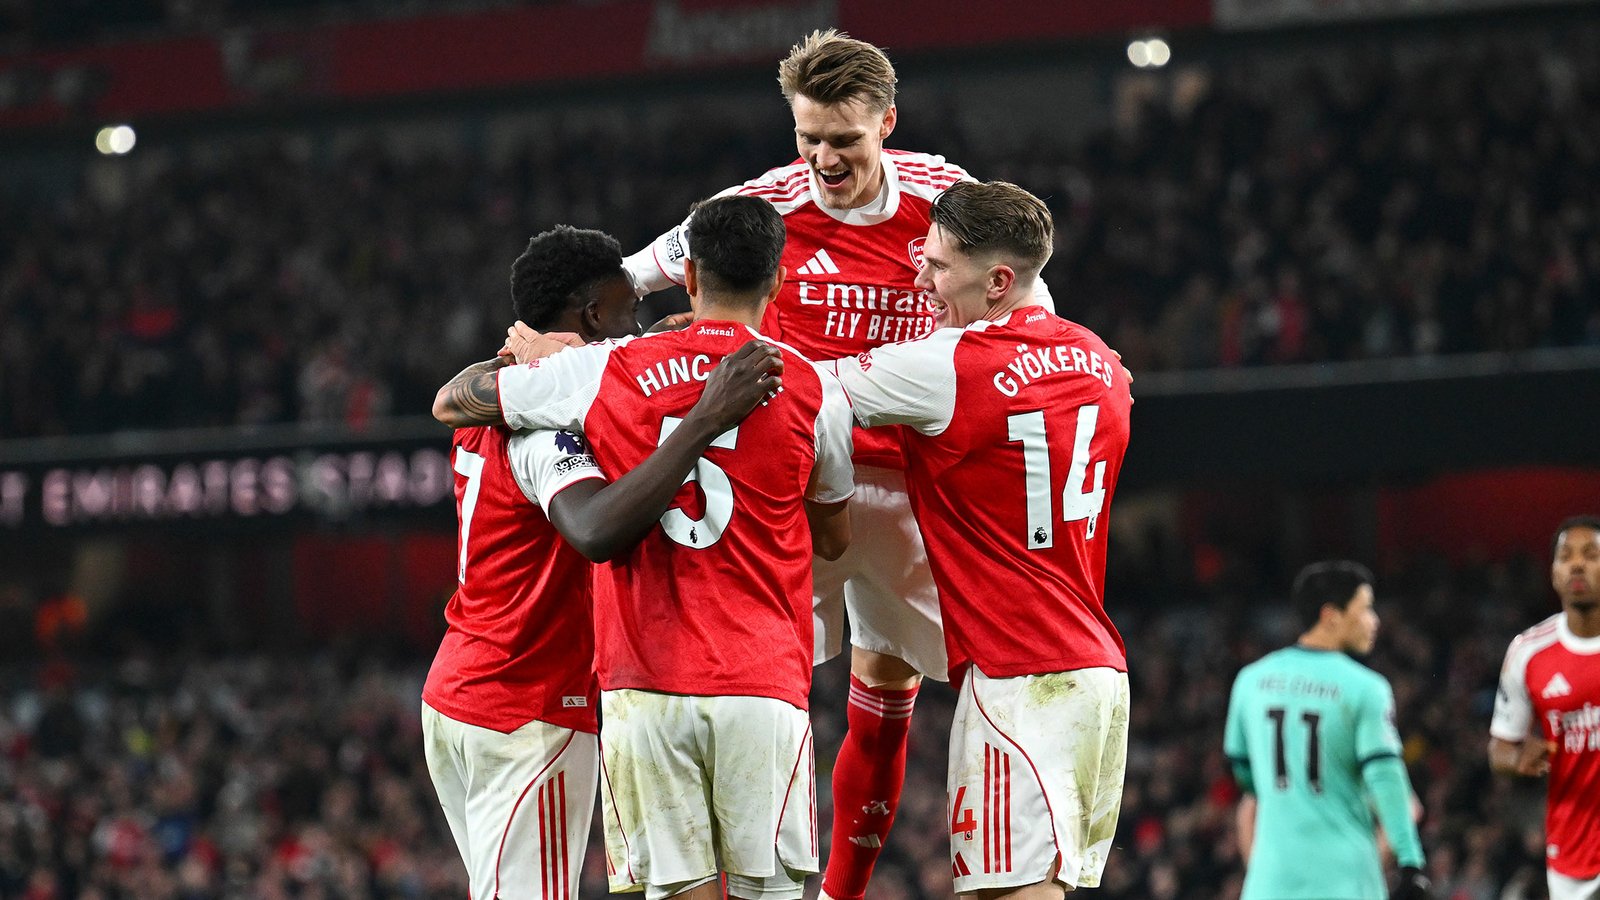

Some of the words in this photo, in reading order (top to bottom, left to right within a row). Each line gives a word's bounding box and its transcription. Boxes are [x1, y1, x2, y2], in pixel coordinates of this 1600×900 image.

[697, 326, 735, 337] Arsenal
[824, 311, 862, 338] FLY
[993, 343, 1113, 397] GYÖKERES
[658, 416, 739, 549] 5
[1007, 404, 1107, 550] 14
[453, 445, 486, 586] 7
[1266, 709, 1322, 793] 11
[947, 786, 978, 841] 4
